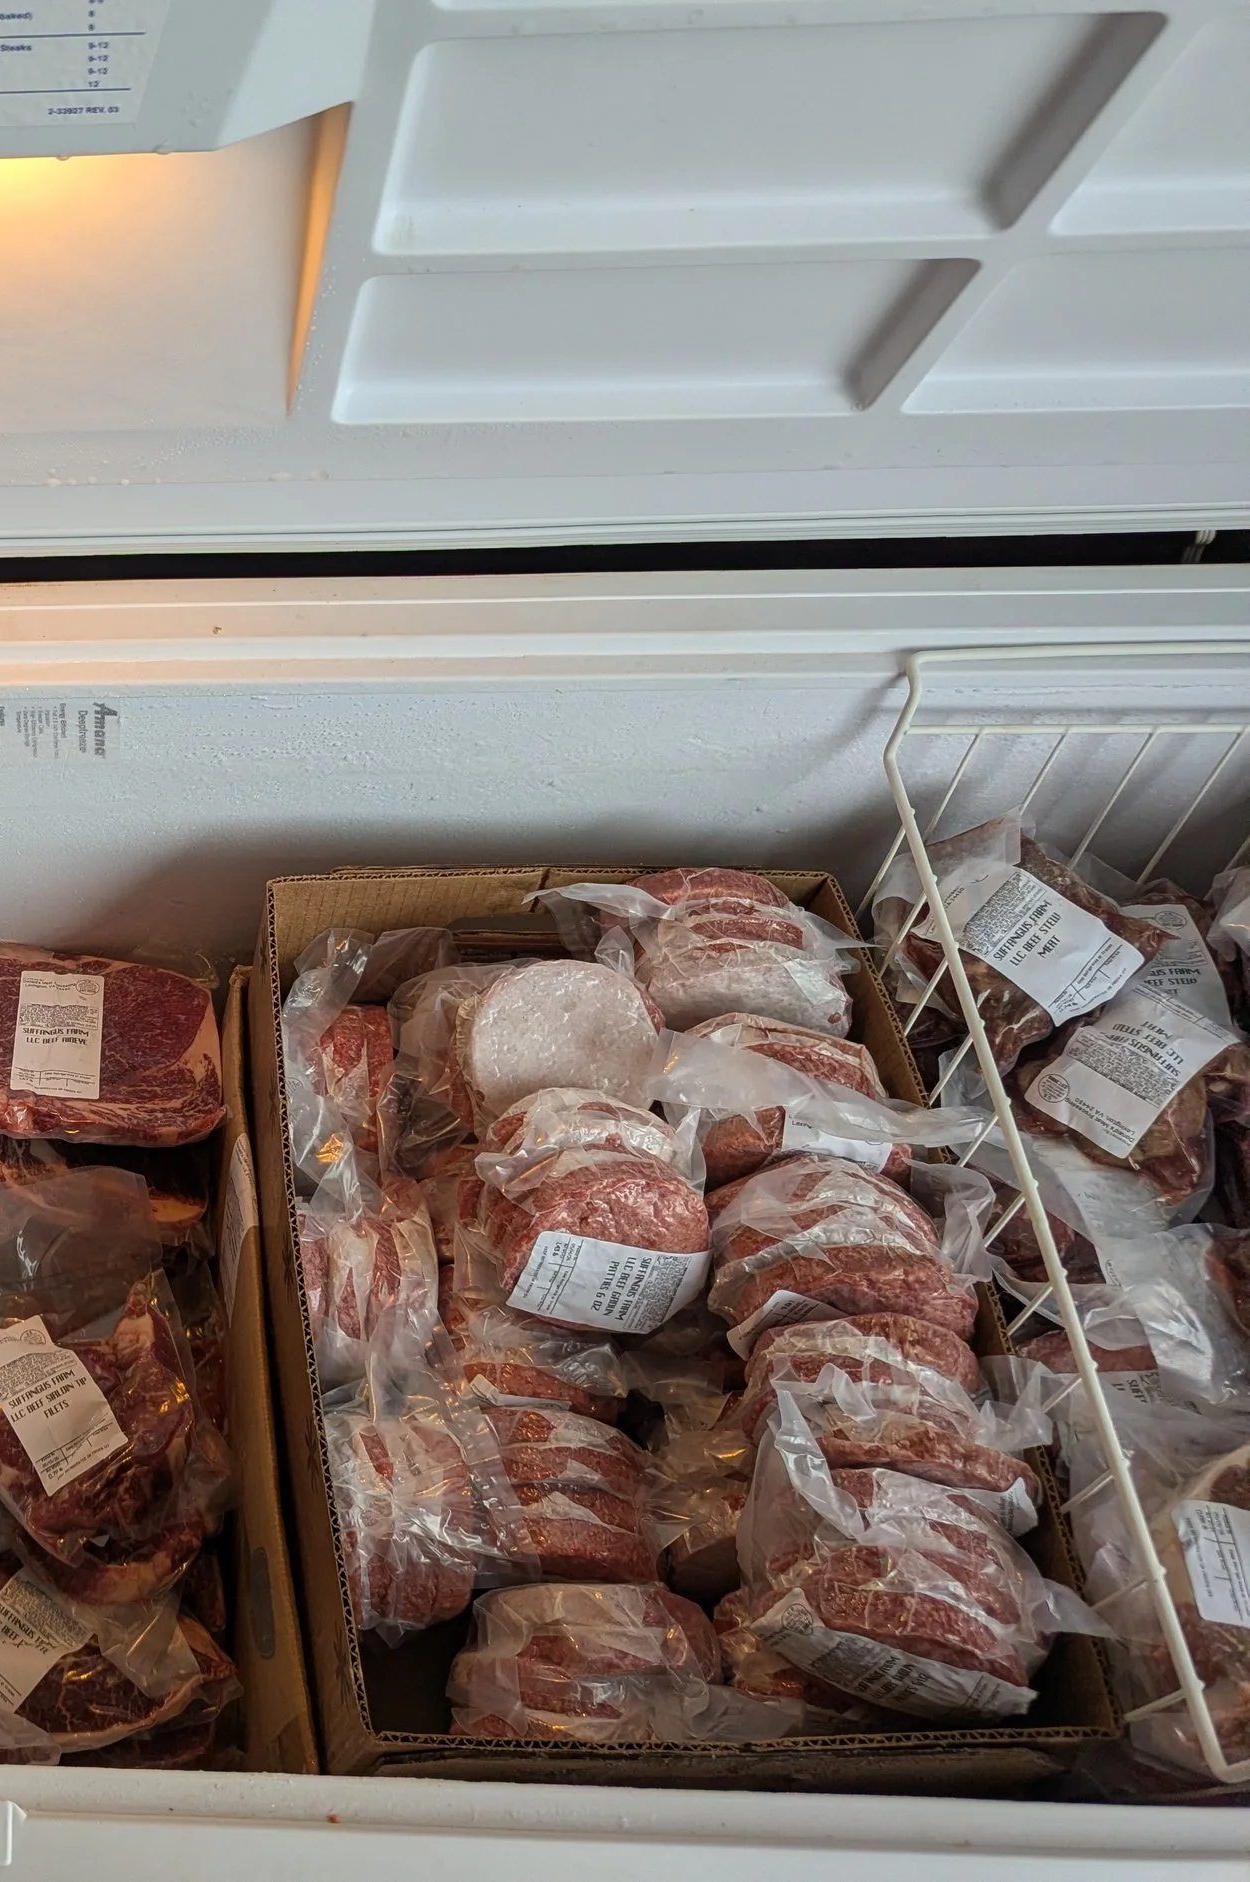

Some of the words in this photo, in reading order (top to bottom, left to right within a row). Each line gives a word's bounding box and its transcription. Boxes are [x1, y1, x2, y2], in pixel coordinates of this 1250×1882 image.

[0, 44, 32, 52] Steaks
[92, 702, 119, 756] Amana
[993, 920, 1033, 960] SUFFANGUS
[1028, 900, 1052, 923] FARM
[1010, 950, 1027, 966] LLC
[1022, 934, 1040, 952] BEEF
[1038, 912, 1061, 934] STEW
[1038, 935, 1060, 958] MEAT
[22, 1025, 63, 1036] SUFFANGUS
[66, 1028, 89, 1037] FARM
[1112, 1024, 1142, 1036] STEW
[1140, 1021, 1172, 1039] MEAT
[42, 1036, 58, 1044] BEEF
[1143, 1034, 1167, 1050] BEEF
[1128, 1038, 1179, 1076] SUFFANGUS
[1165, 1047, 1184, 1065] LLC
[1065, 1097, 1094, 1119] Processing
[1094, 1108, 1105, 1117] VA
[1094, 1117, 1109, 1128] Meat
[1110, 1126, 1134, 1142] Donald's
[623, 1257, 636, 1270] LLC
[599, 1261, 620, 1290] PATTIES
[616, 1272, 630, 1290] BEEF
[626, 1258, 651, 1298] SUFFANGUS
[593, 1300, 601, 1311] OZ
[603, 1291, 621, 1316] GROUN
[615, 1300, 633, 1321] FARM
[8, 1380, 52, 1408] SUFFANGUS
[51, 1370, 75, 1385] FARM
[10, 1409, 24, 1422] LLC
[26, 1398, 43, 1413] BEEF
[45, 1384, 75, 1402] SIRLOIN
[74, 1376, 88, 1388] TIP
[44, 1400, 69, 1418] FILETS
[1, 1625, 19, 1640] BEEF
